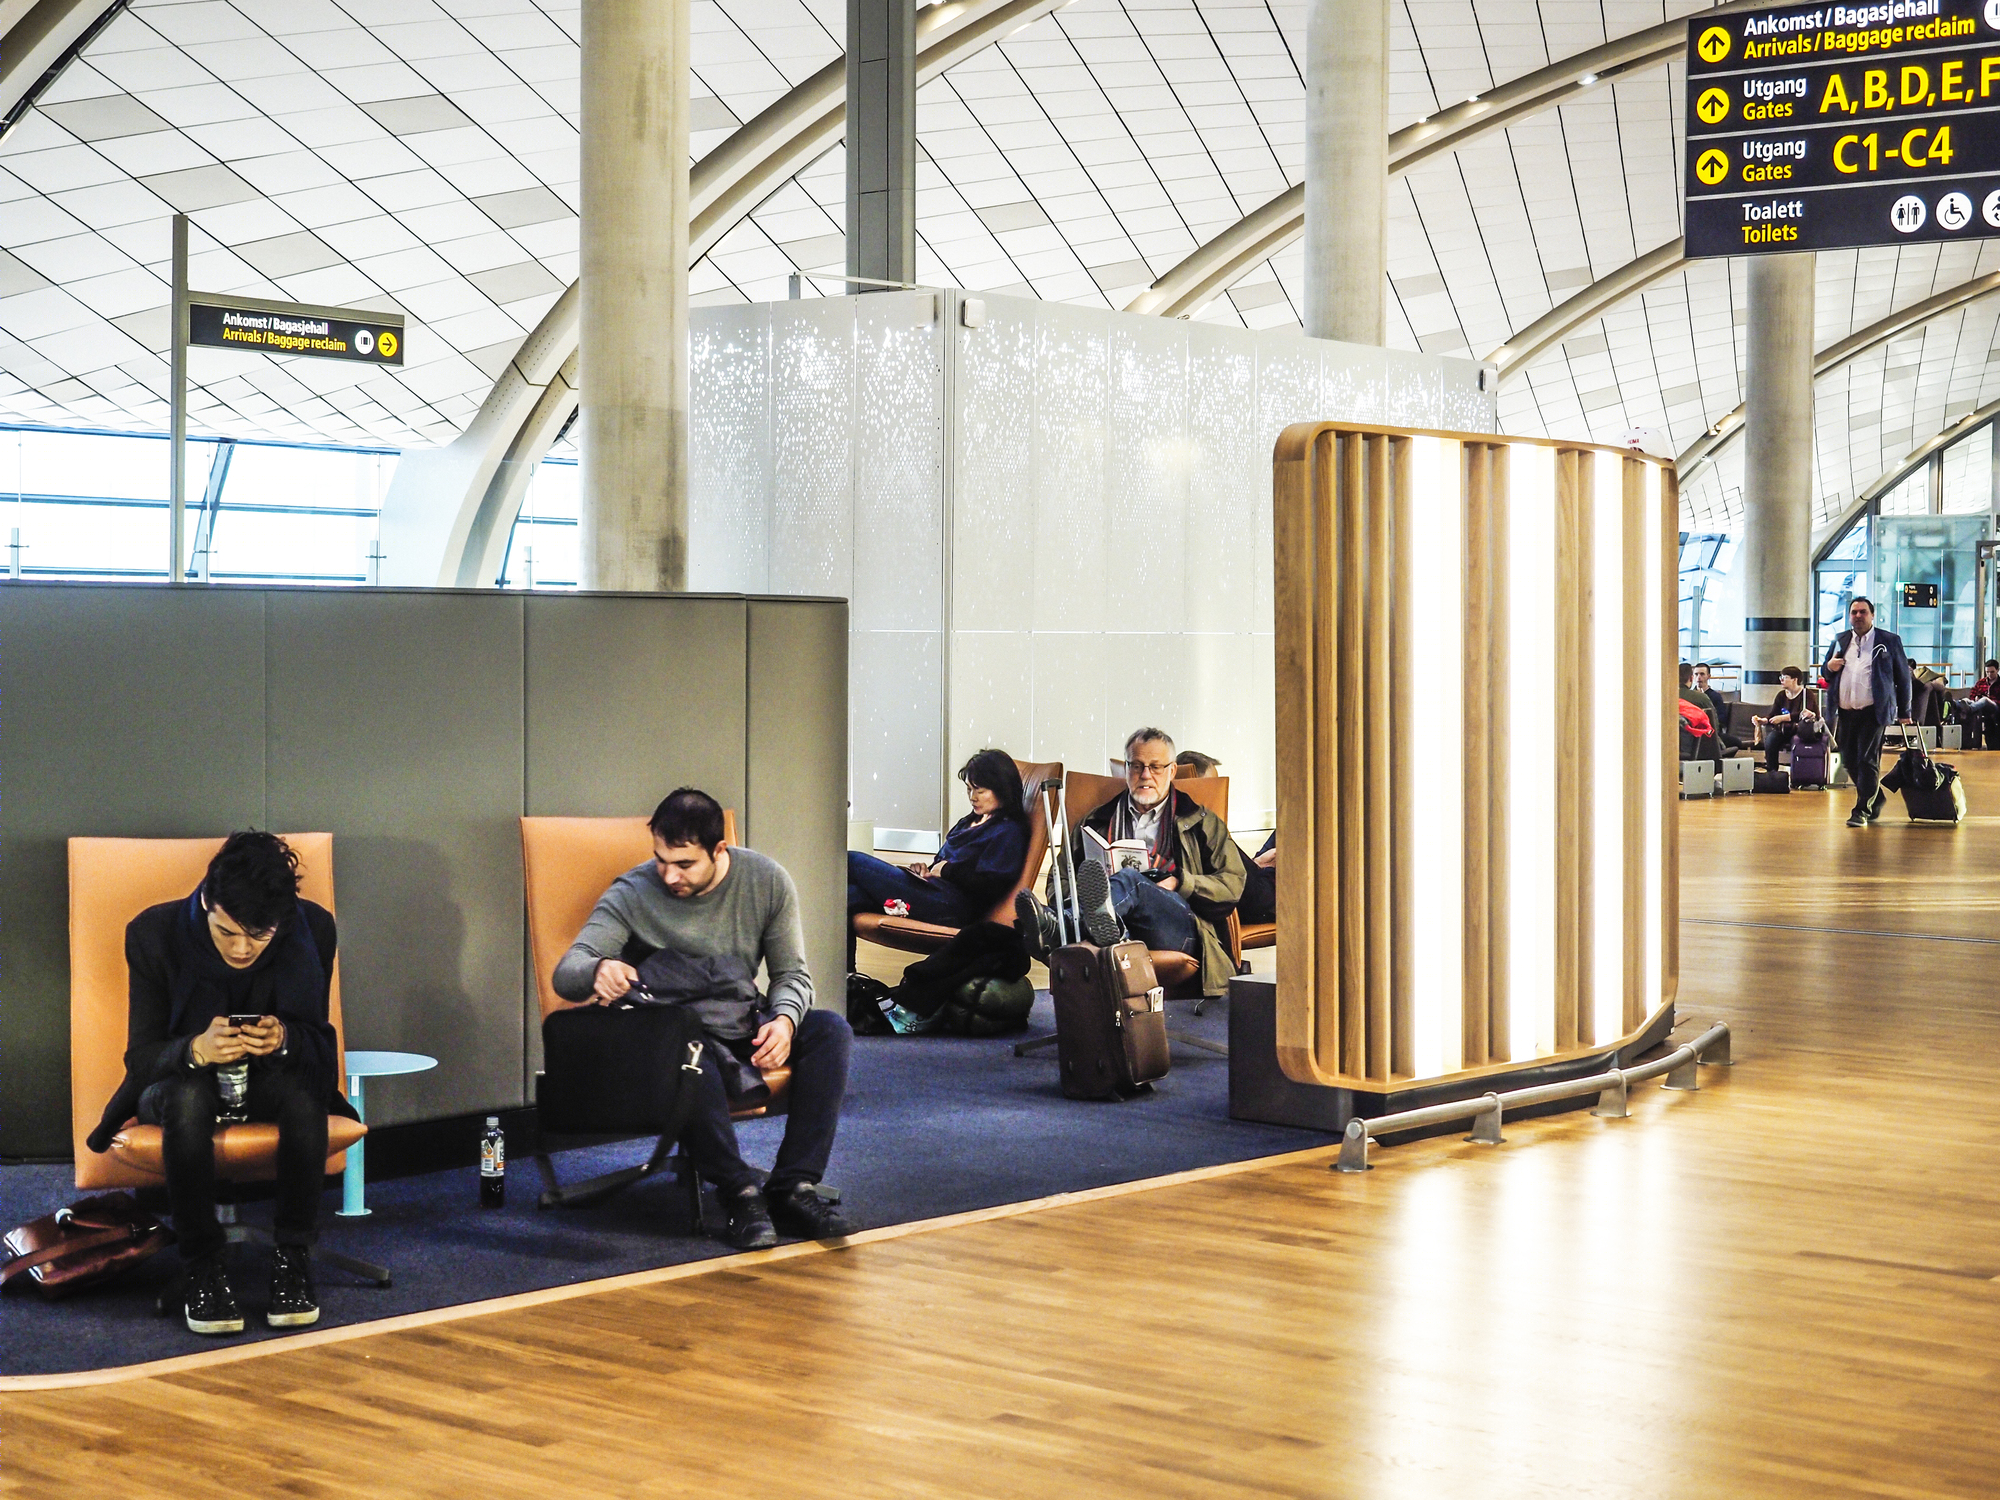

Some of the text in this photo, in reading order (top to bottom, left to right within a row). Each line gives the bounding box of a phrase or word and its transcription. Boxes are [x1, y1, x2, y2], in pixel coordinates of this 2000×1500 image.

[1744, 11, 1822, 36] Ankomst
[1835, 0, 1939, 28] Bagasjehall
[1743, 34, 1811, 59] Arrivals
[1824, 28, 1902, 52] Baggage
[1906, 16, 1975, 41] reclaim
[1743, 78, 1807, 100] Utgang
[1743, 102, 1793, 121] Gates
[1742, 126, 1953, 174] Utgang C1-C4
[1742, 163, 1792, 182] Gates
[1742, 200, 1803, 220] Toalett
[1742, 223, 1798, 243] Toilets
[223, 312, 267, 329] Ankomst
[273, 317, 329, 335] Bagasjehall
[223, 327, 261, 343] Arrivals
[268, 332, 310, 350] Baggage
[311, 337, 347, 351] reclaim
